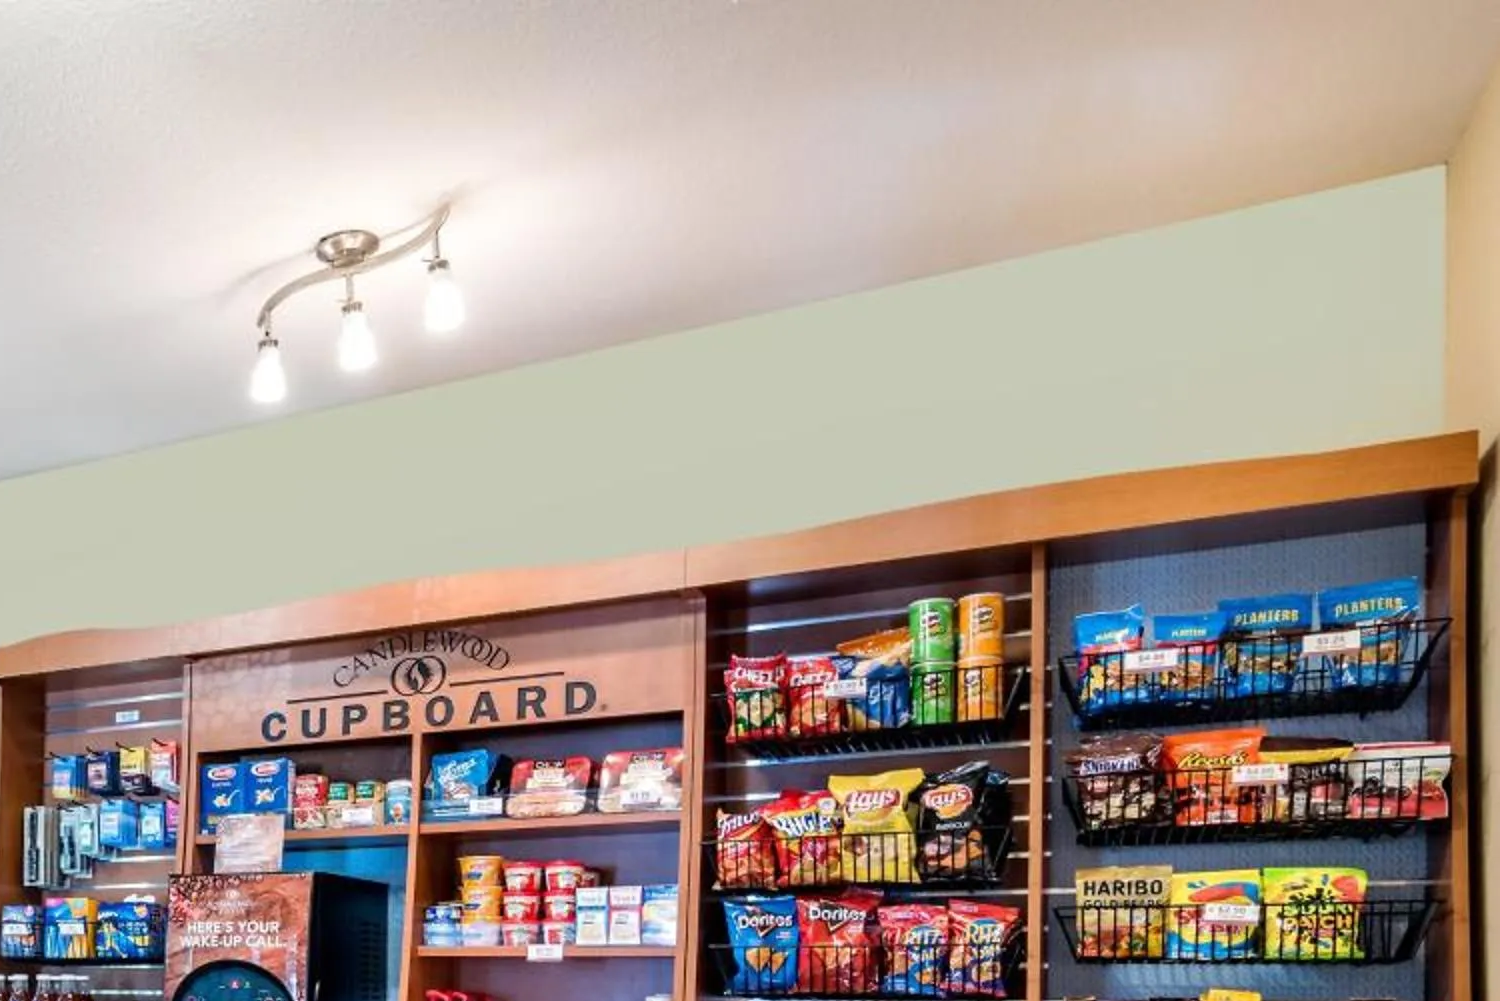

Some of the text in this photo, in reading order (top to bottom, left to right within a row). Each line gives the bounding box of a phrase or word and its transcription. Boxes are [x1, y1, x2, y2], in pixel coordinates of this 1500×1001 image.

[1335, 597, 1404, 617] PLANTERS
[1234, 608, 1299, 626] PLANTERS
[333, 629, 512, 688] CANDLEWOOD
[260, 681, 598, 743] CUPBOARD
[1083, 879, 1163, 896] HARIBO
[738, 914, 794, 931] Doritos
[808, 906, 868, 923] Doritos
[1284, 915, 1353, 930] PATCH
[187, 920, 280, 934] HERE'S YOUR
[179, 934, 289, 948] WAKE-UP CALL.
